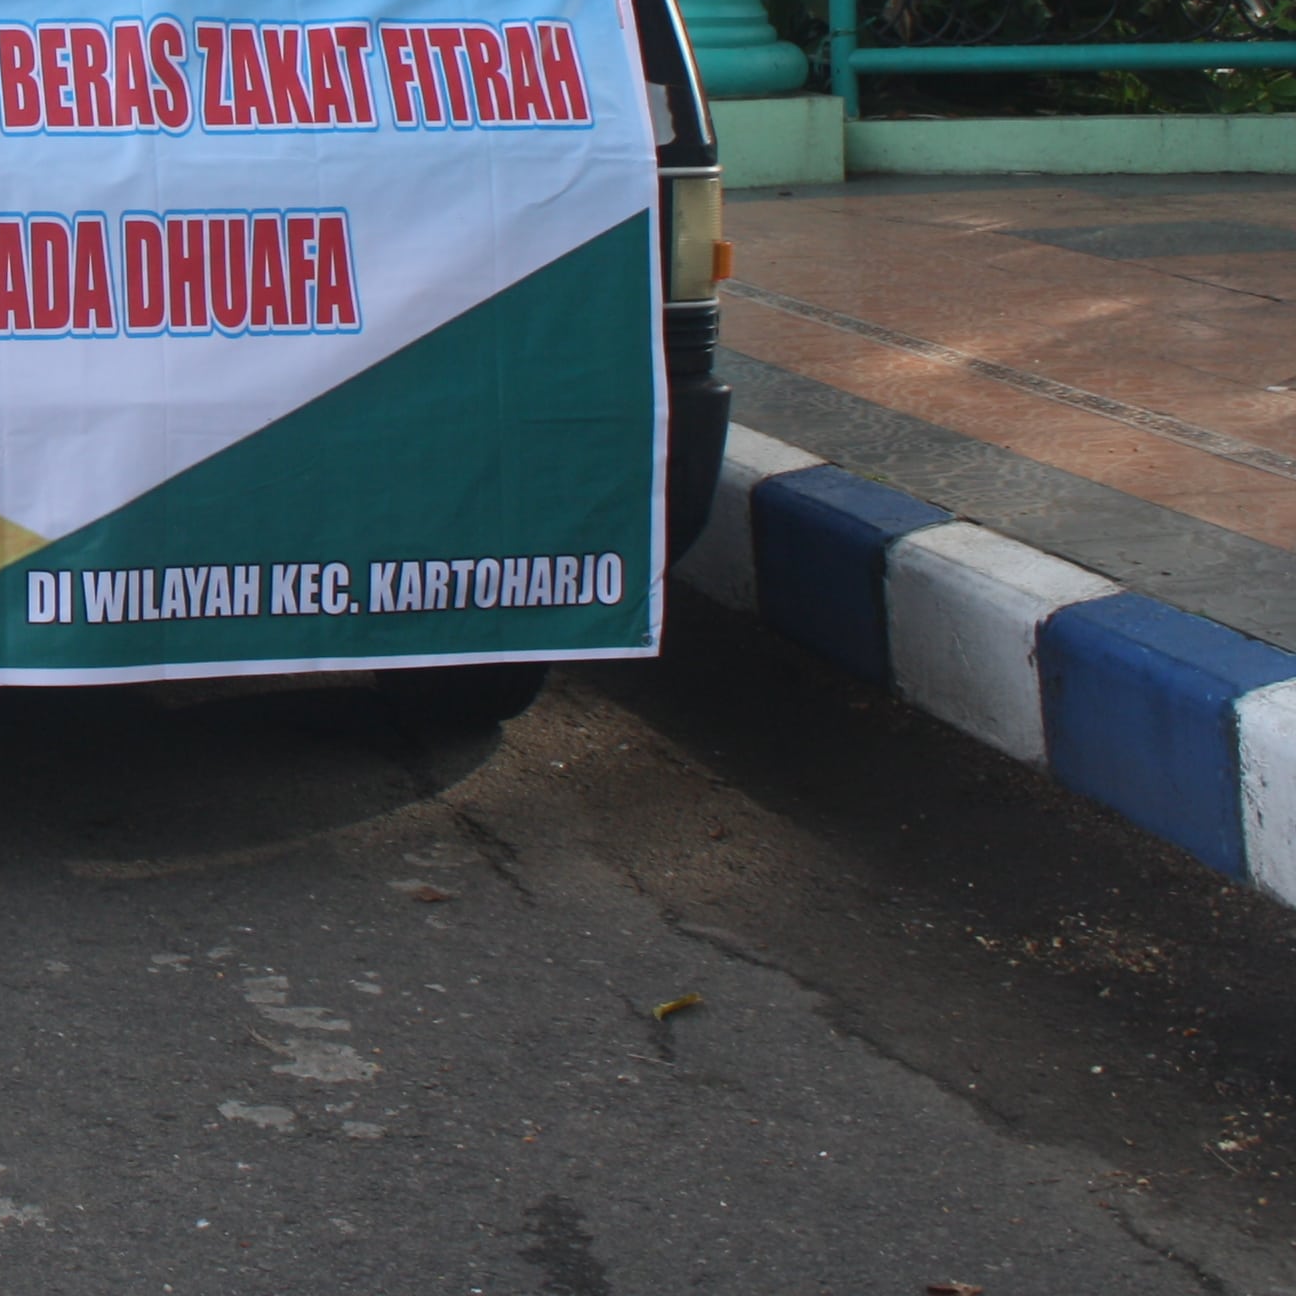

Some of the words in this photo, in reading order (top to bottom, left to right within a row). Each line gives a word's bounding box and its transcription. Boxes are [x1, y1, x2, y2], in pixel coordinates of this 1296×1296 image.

[3, 24, 190, 131] BERAS
[199, 26, 373, 127] ZAKAT
[381, 26, 589, 124] FITRAH
[125, 216, 357, 332] DHUAFA
[28, 571, 72, 623] DI
[82, 565, 262, 624] WILAYAH
[271, 563, 360, 616] KEC.
[370, 553, 623, 613] KARTOHARJO
